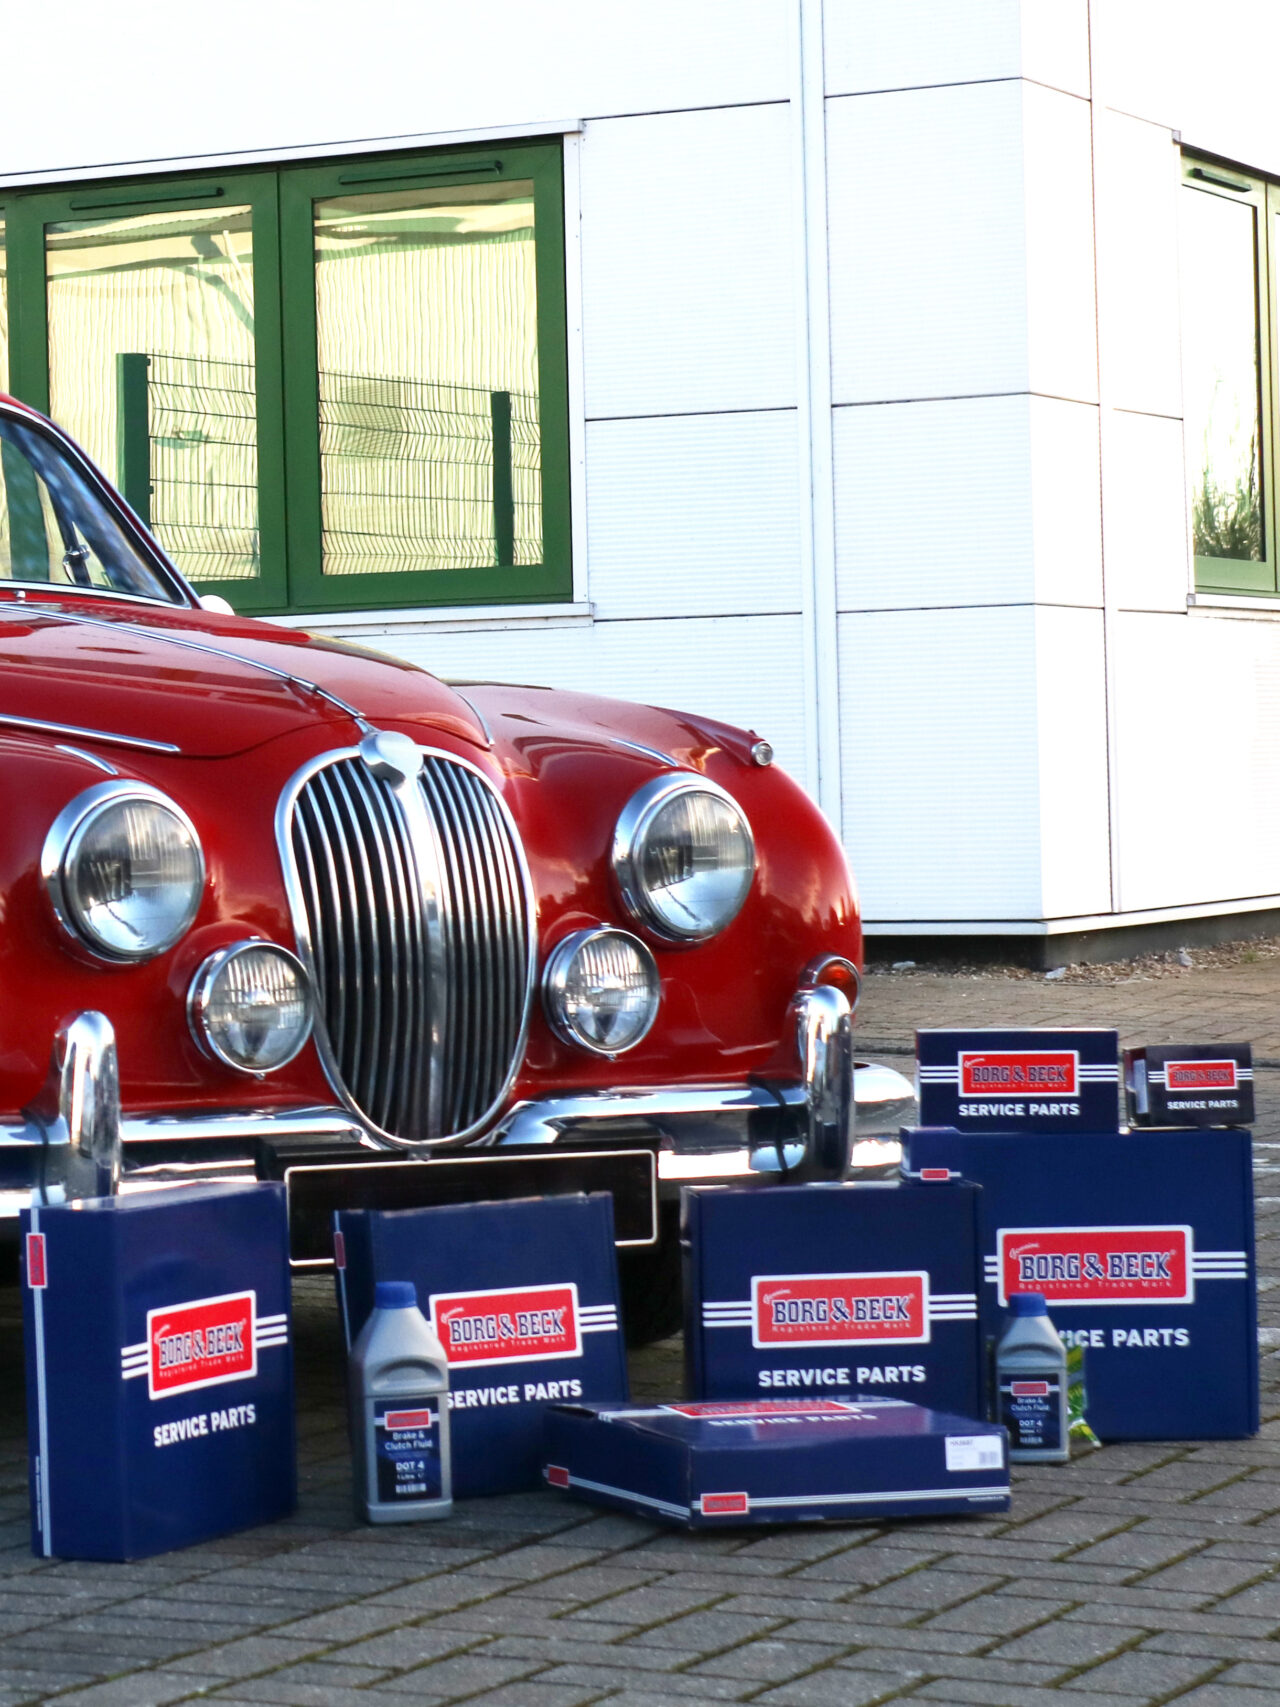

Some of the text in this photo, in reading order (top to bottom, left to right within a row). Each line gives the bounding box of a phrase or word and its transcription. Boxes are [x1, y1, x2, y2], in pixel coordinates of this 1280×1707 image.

[972, 1065, 1067, 1083] BORG & BECK
[958, 1102, 1081, 1117] SERVICE PARTS
[1166, 1099, 1239, 1110] SERVICE PARTS
[1018, 1251, 1172, 1282] BORG & BECK
[1019, 1282, 1090, 1291] Registered
[772, 1296, 911, 1325] BORG & BECK
[449, 1315, 497, 1345] BORG
[497, 1313, 516, 1338] &
[516, 1308, 566, 1338] BECK
[1112, 1327, 1191, 1347] PARTS
[158, 1331, 193, 1370] BORG
[191, 1329, 206, 1360] &
[205, 1321, 245, 1359] BECK
[758, 1364, 927, 1388] SERVICE PARTS
[524, 1378, 584, 1402] PARTS
[153, 1403, 257, 1448] SERVICE PARTS
[395, 1461, 416, 1471] DOT
